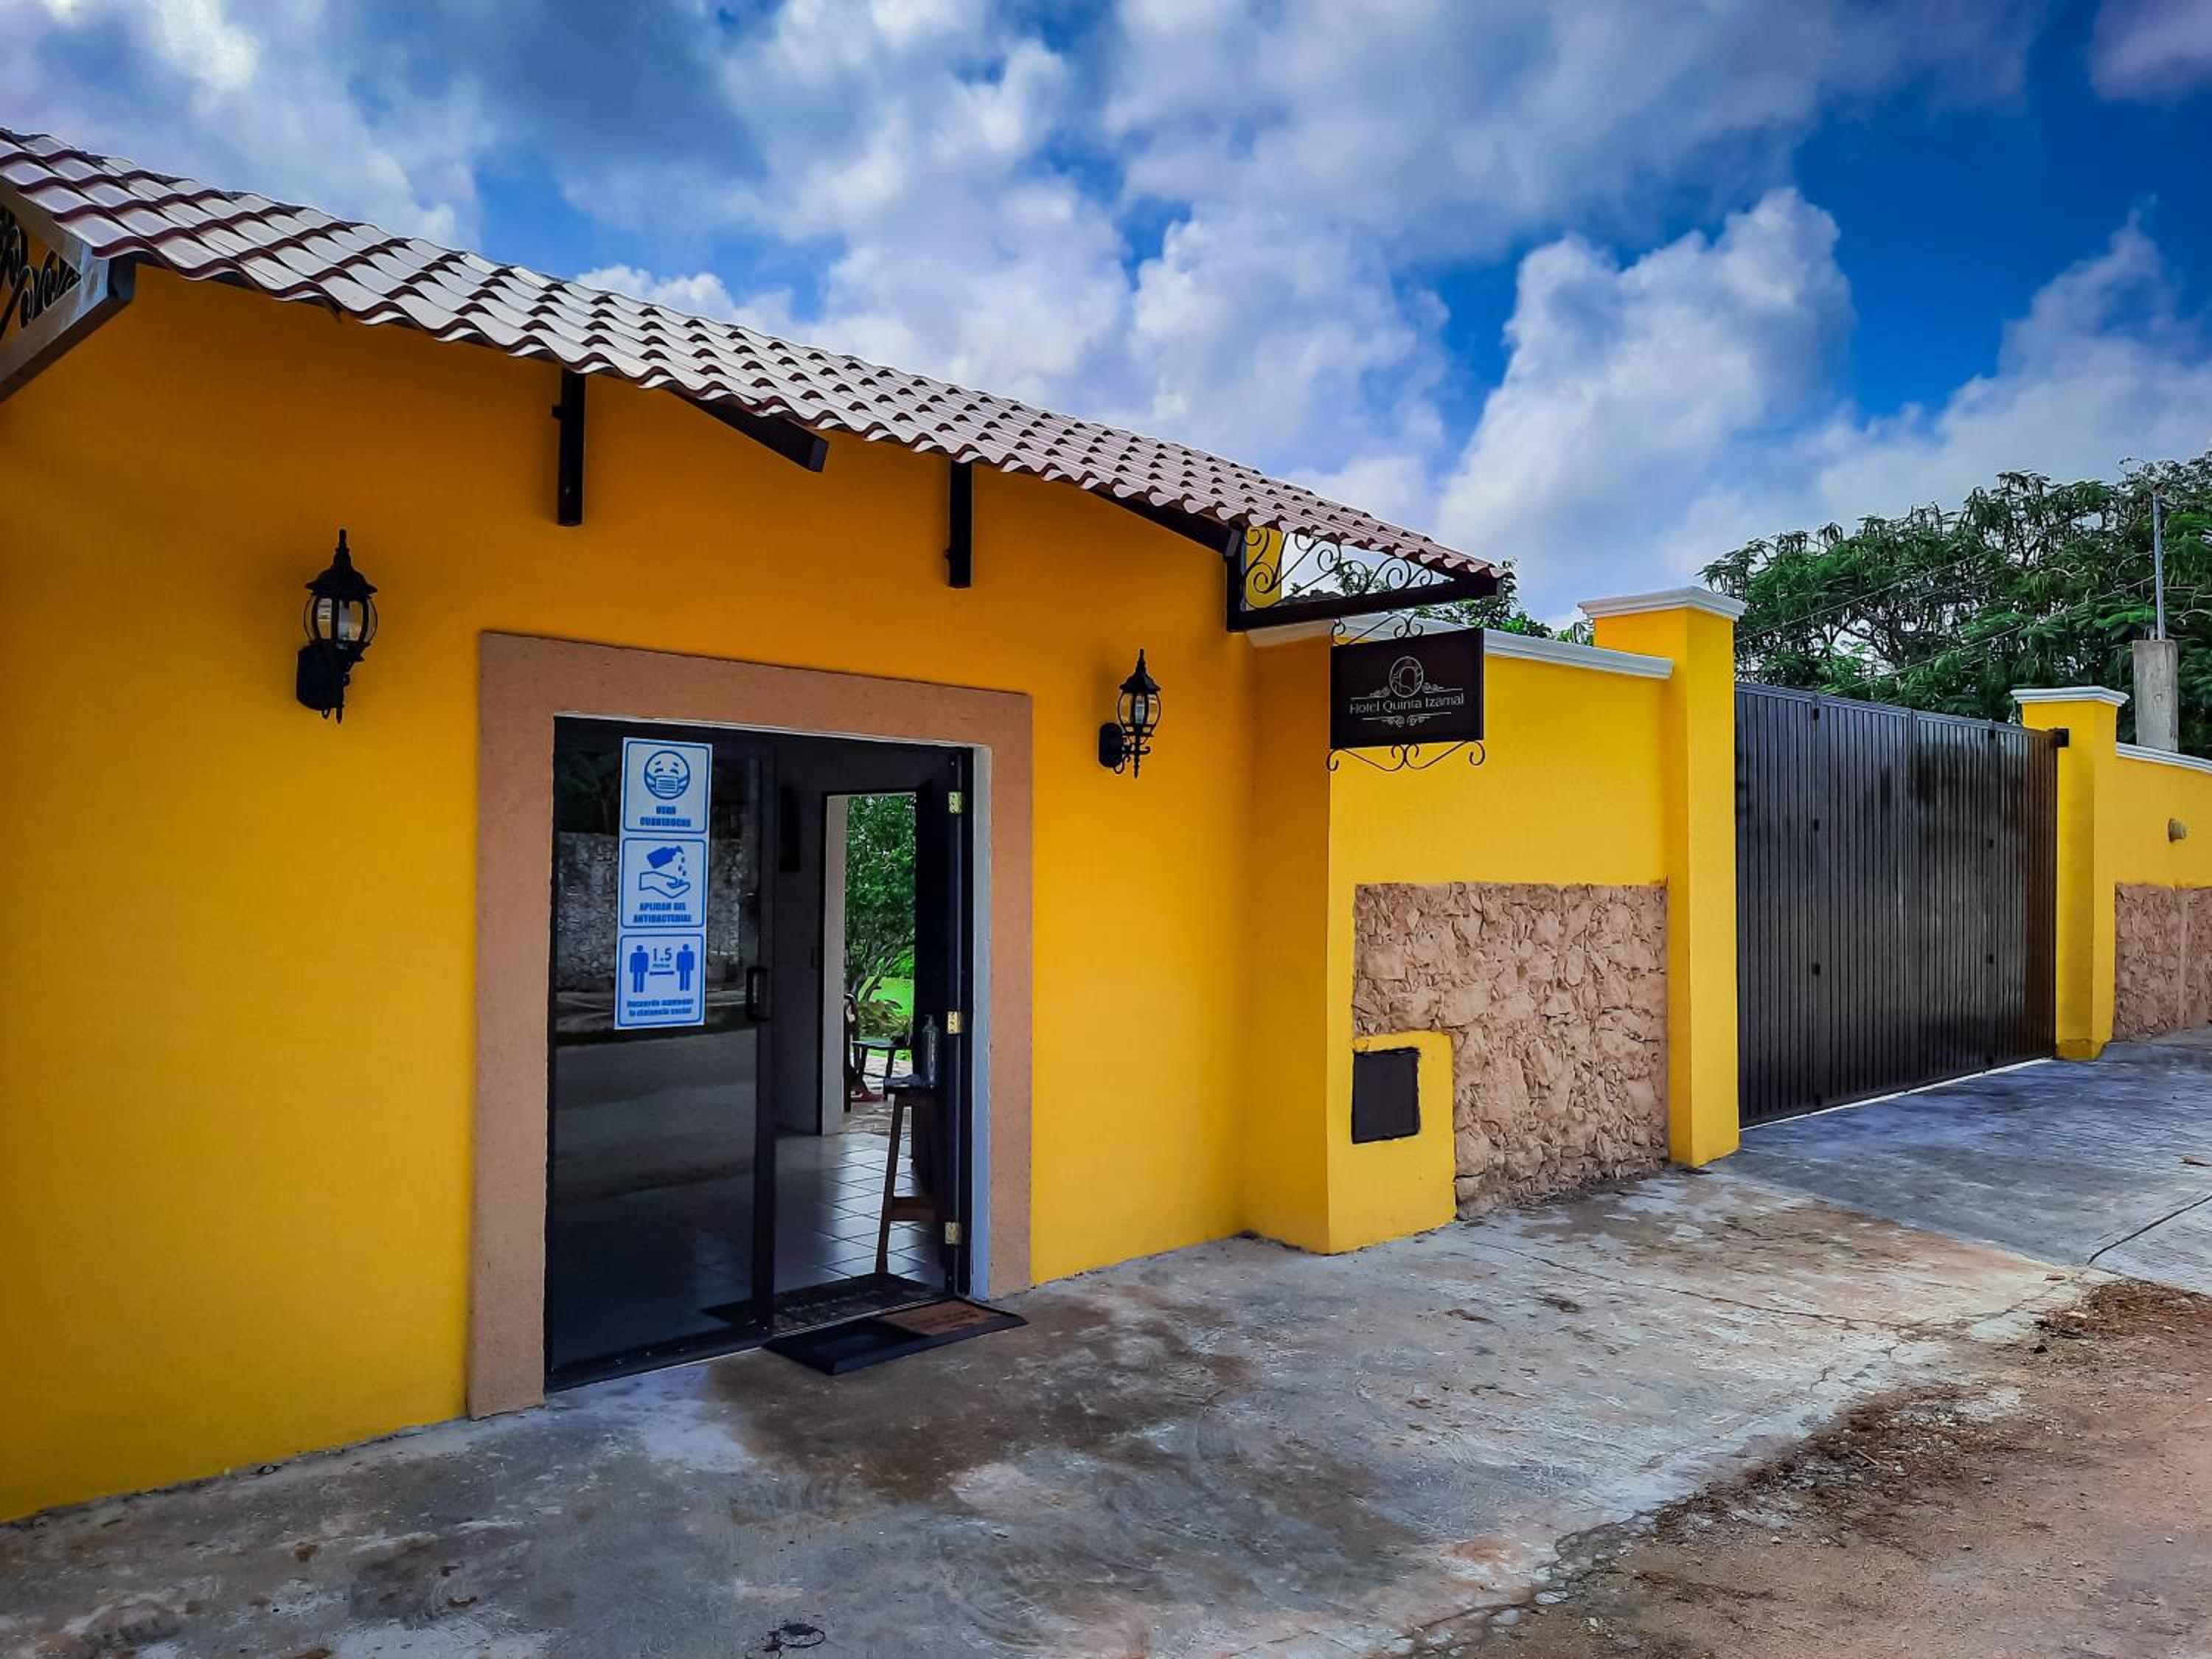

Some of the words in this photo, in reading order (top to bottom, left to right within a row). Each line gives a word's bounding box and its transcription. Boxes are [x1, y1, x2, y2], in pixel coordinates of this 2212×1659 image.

[1349, 701, 1380, 714] Hotel
[1382, 699, 1422, 713] Quinta
[1425, 692, 1464, 709] Izamal
[653, 947, 672, 961] 1.5
